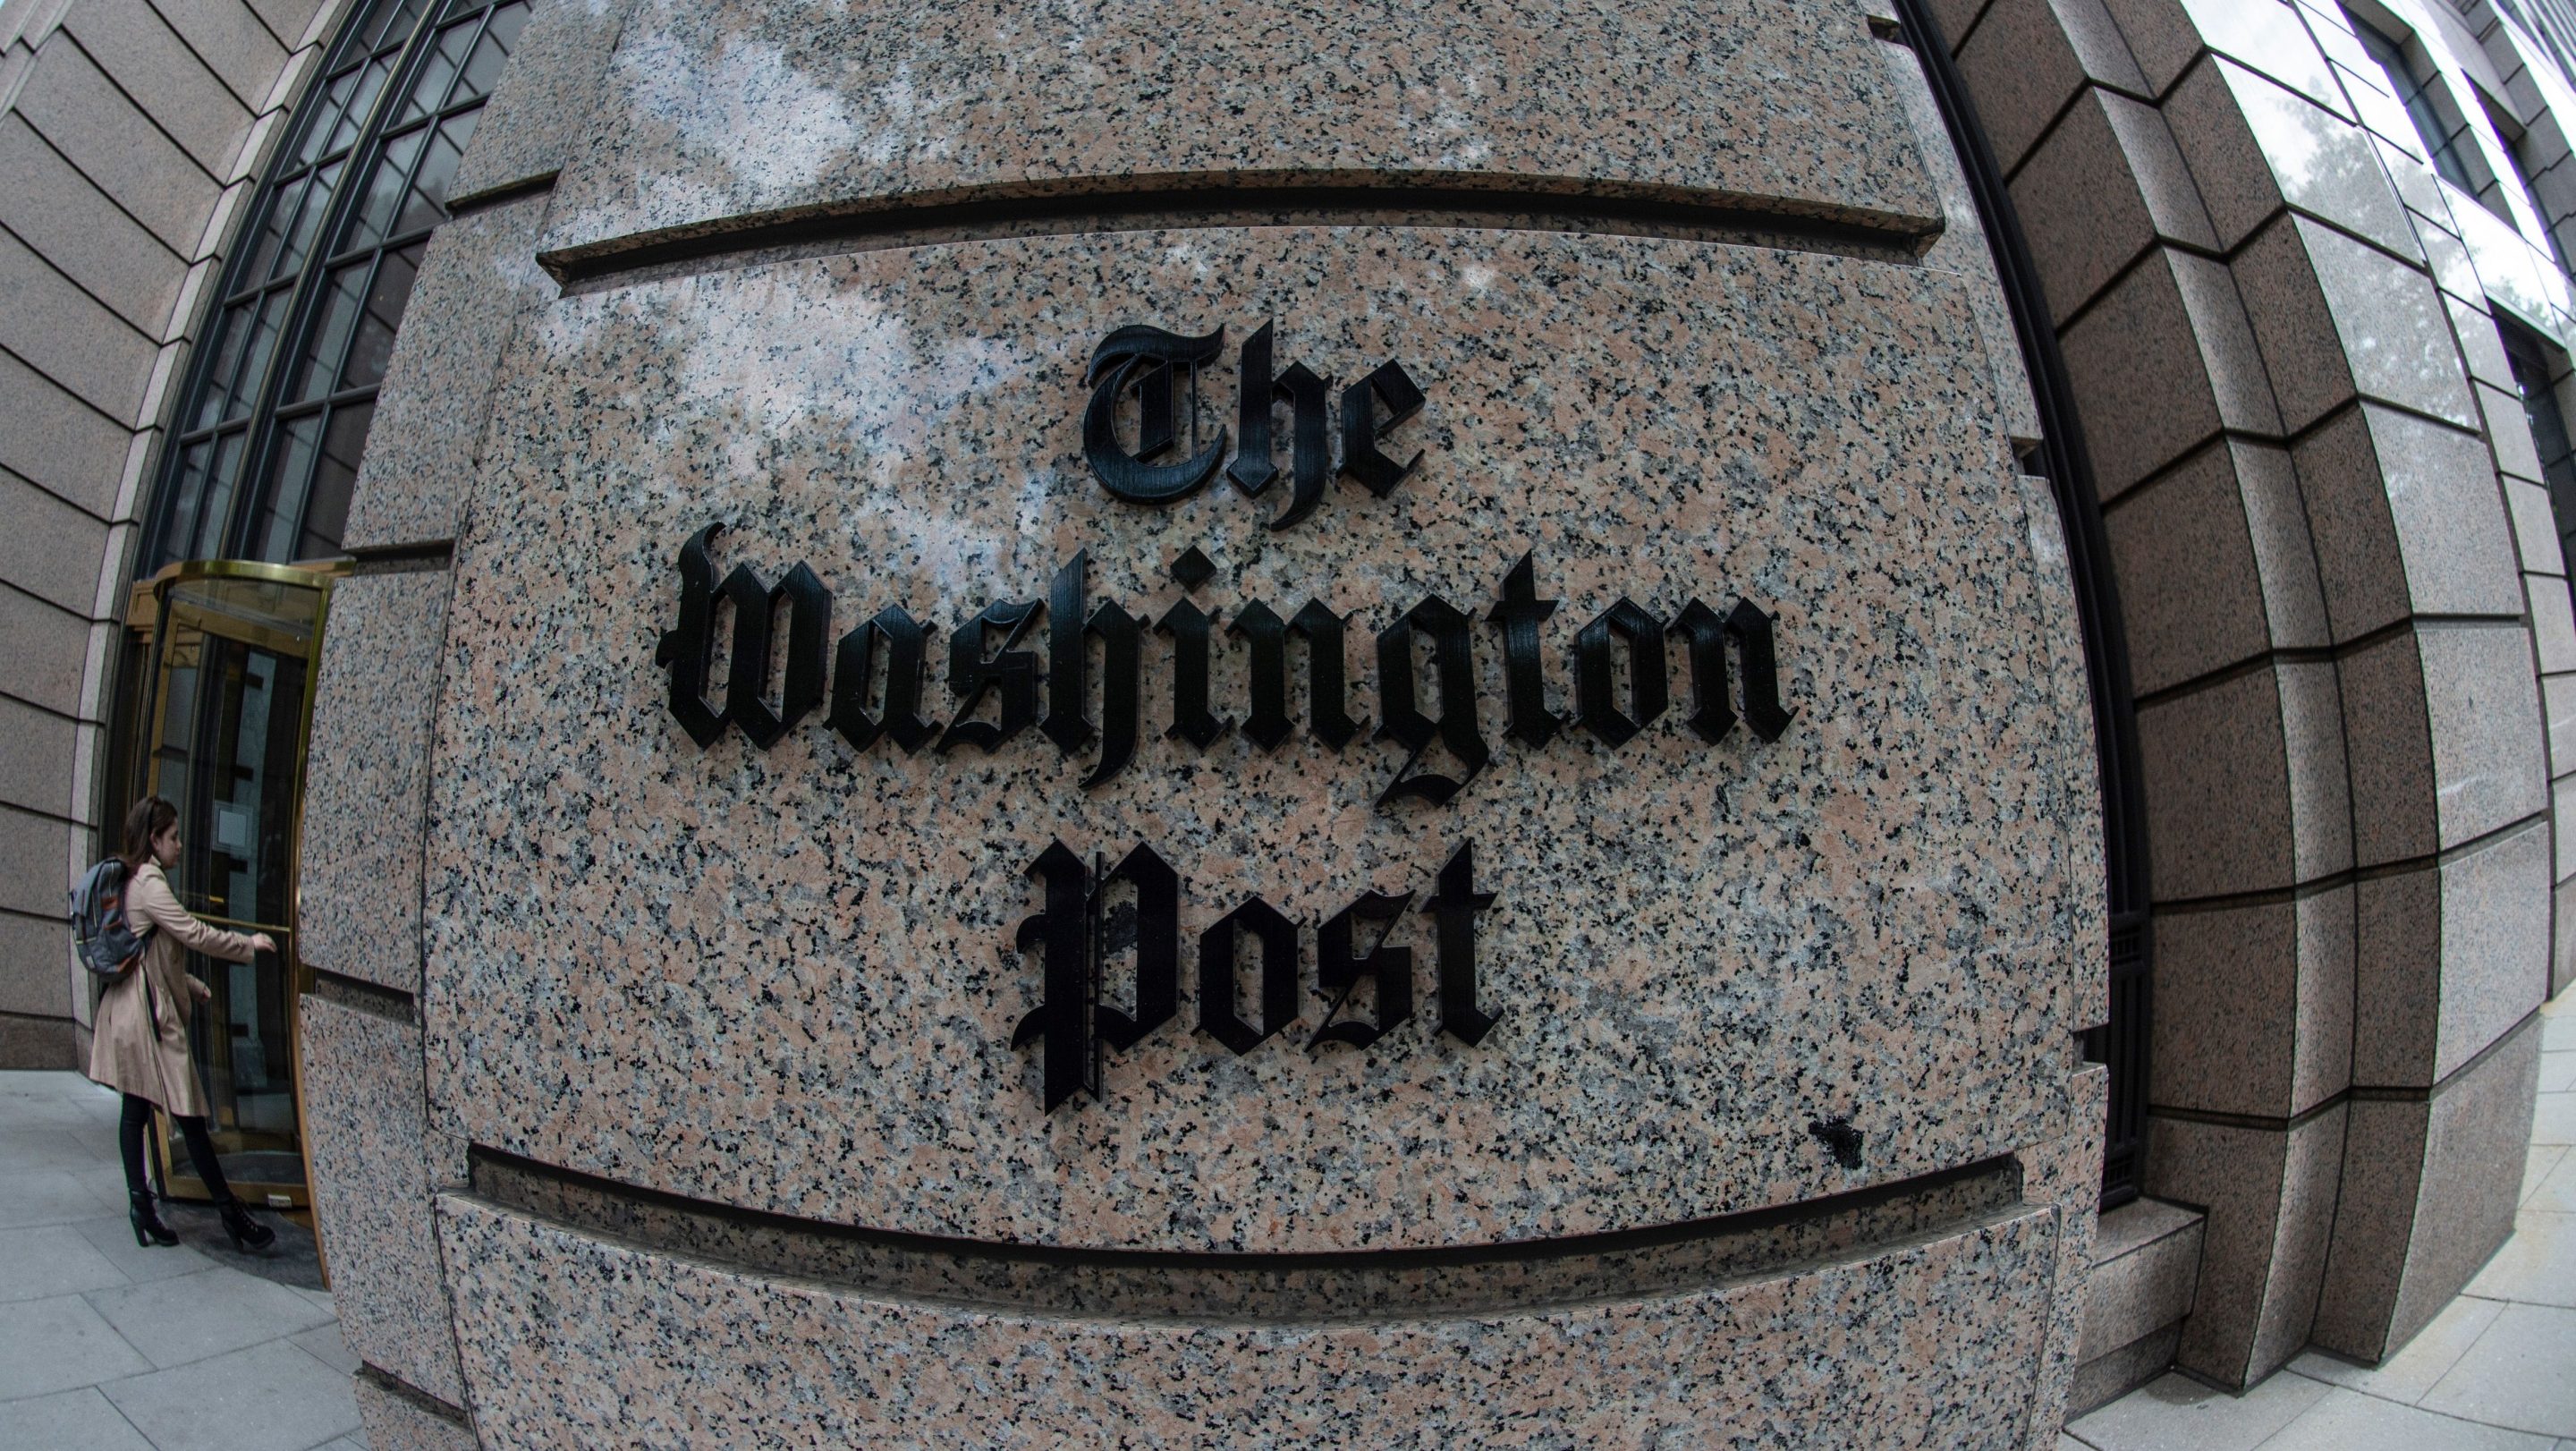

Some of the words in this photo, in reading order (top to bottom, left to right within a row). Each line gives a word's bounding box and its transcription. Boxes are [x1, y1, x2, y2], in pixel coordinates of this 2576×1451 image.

[1083, 319, 1427, 531] The
[657, 522, 1798, 807] Washington
[1012, 836, 1504, 1114] Post
